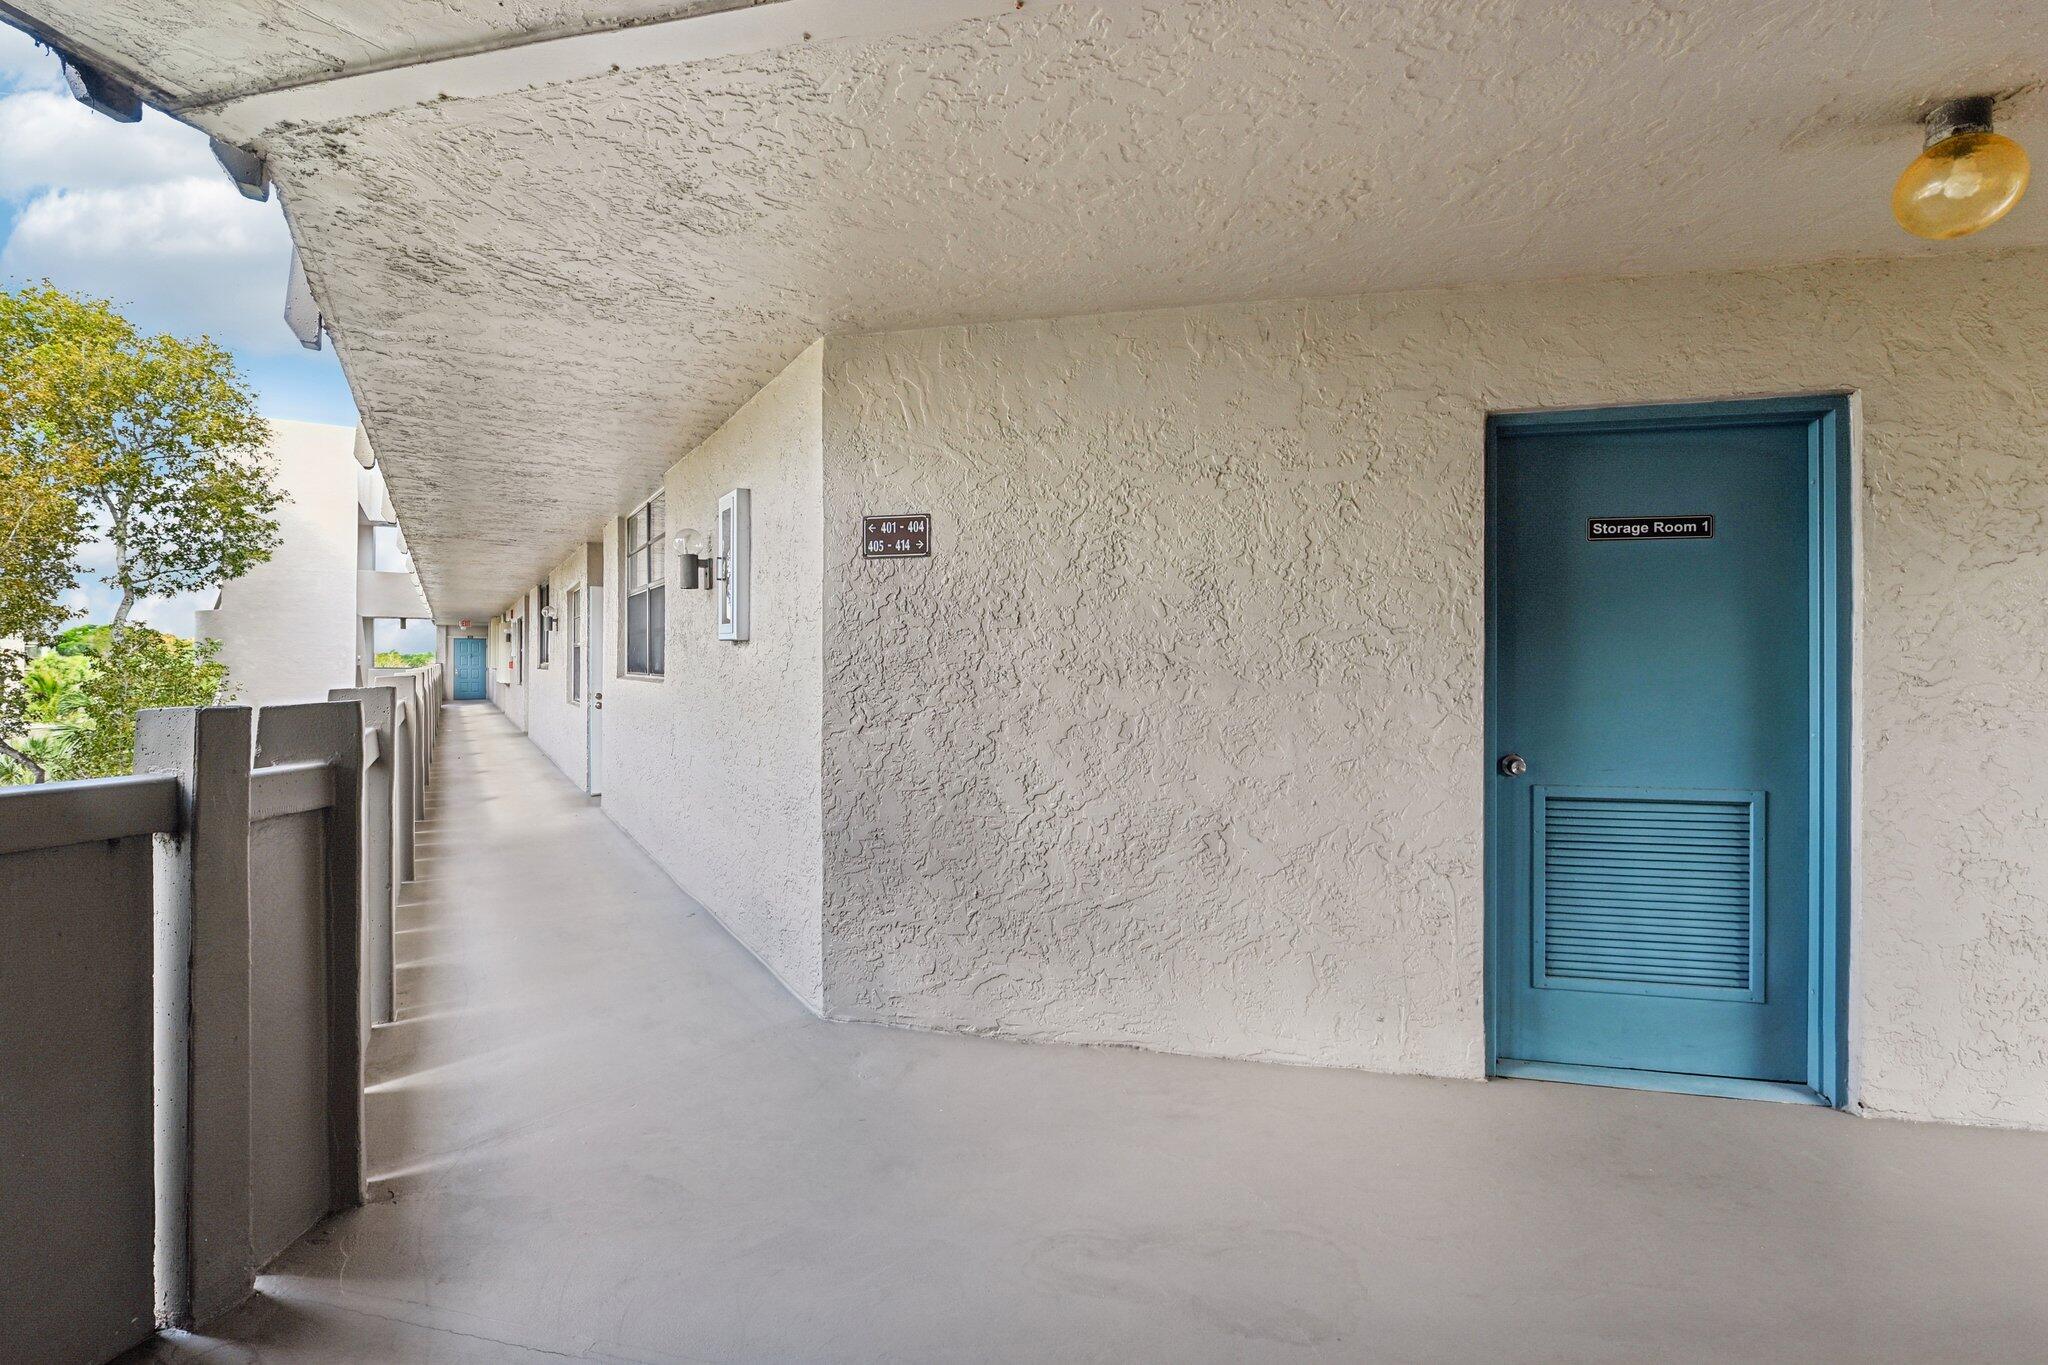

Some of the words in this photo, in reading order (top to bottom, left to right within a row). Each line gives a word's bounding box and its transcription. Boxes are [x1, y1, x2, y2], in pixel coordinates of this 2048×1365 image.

[881, 521, 896, 533] 401
[907, 520, 924, 533] 404
[1593, 523, 1649, 536] Storage
[1653, 521, 1697, 533] Room
[1702, 520, 1708, 532] 1
[867, 540, 884, 552] 405
[895, 539, 910, 551] 414
